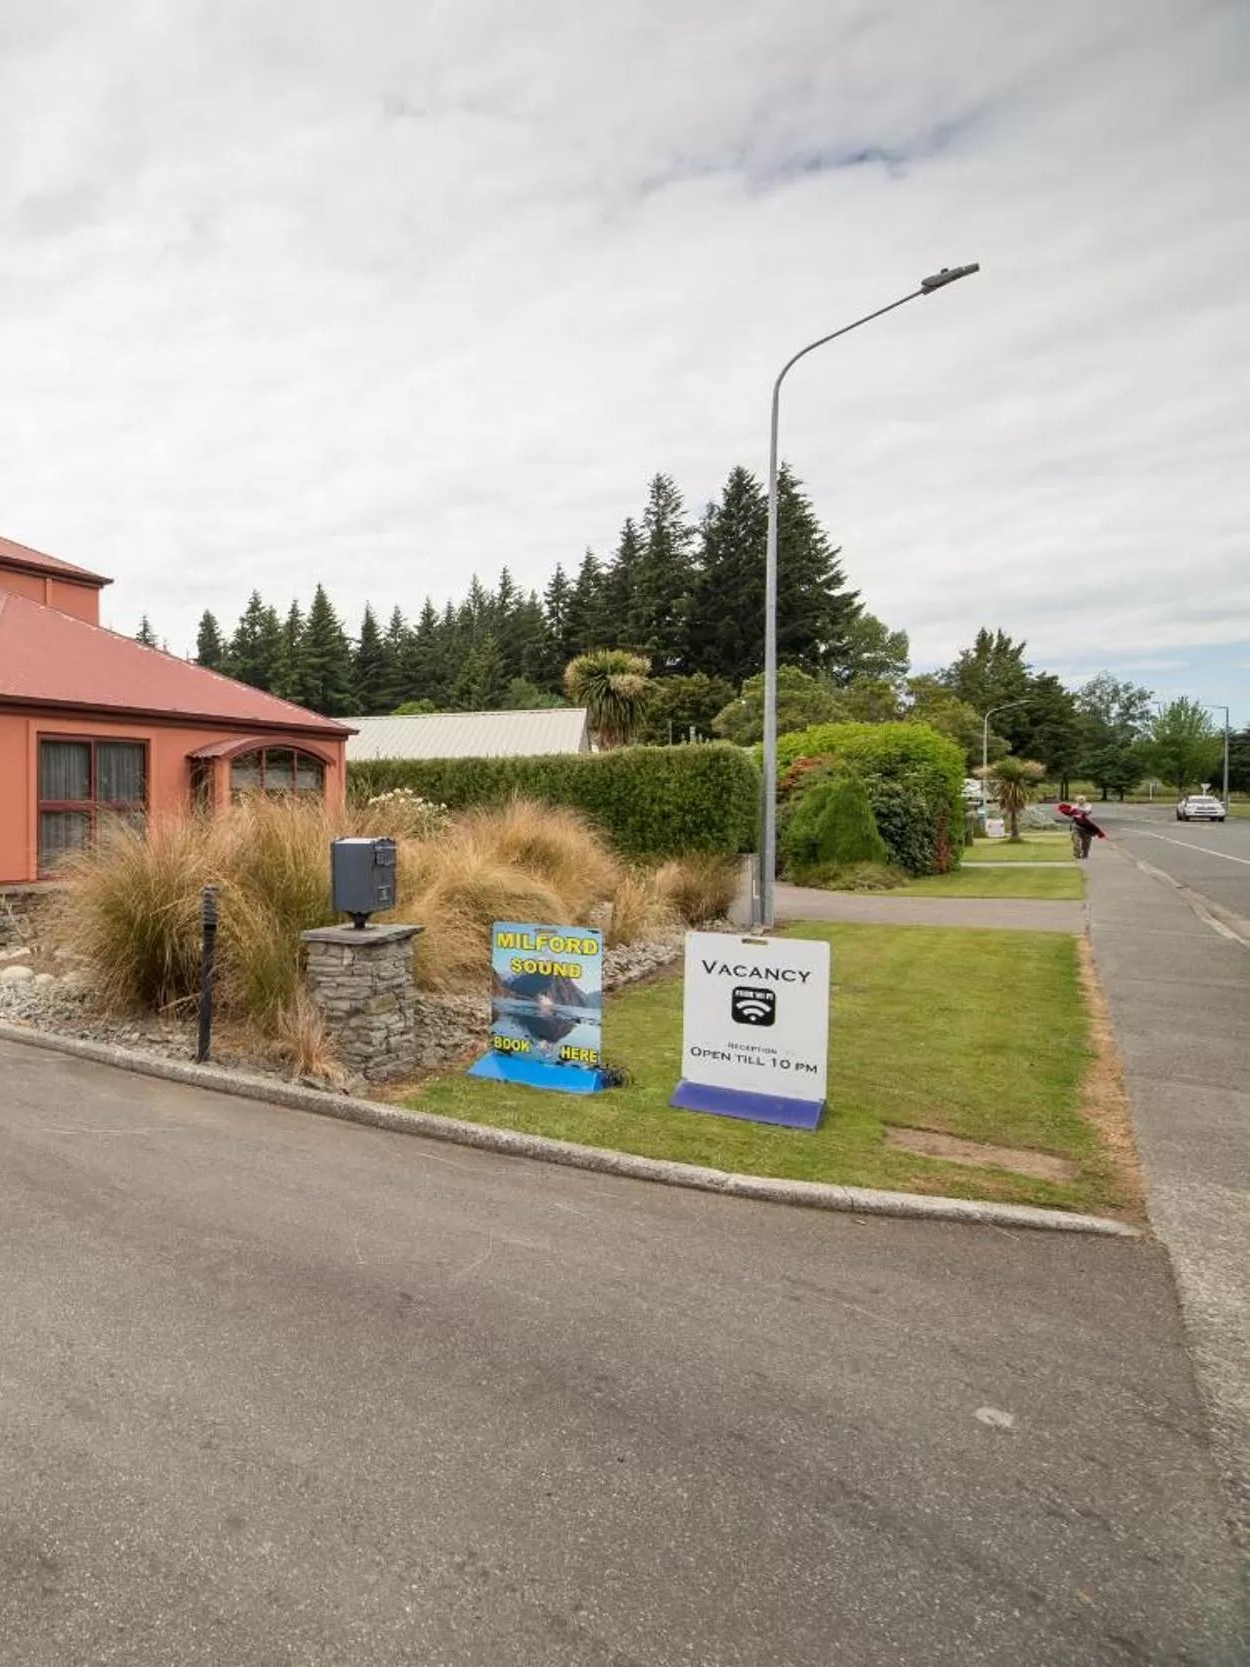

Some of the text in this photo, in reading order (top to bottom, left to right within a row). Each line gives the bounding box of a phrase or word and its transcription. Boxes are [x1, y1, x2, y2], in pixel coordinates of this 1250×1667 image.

[497, 932, 599, 956] MILFORD
[510, 957, 583, 979] SOUND
[702, 959, 812, 984] VACANCY
[493, 1036, 598, 1063] BOOK HERE
[690, 1046, 818, 1074] OPEN TILL 10 PM
[728, 1041, 778, 1055] RECEPTION
